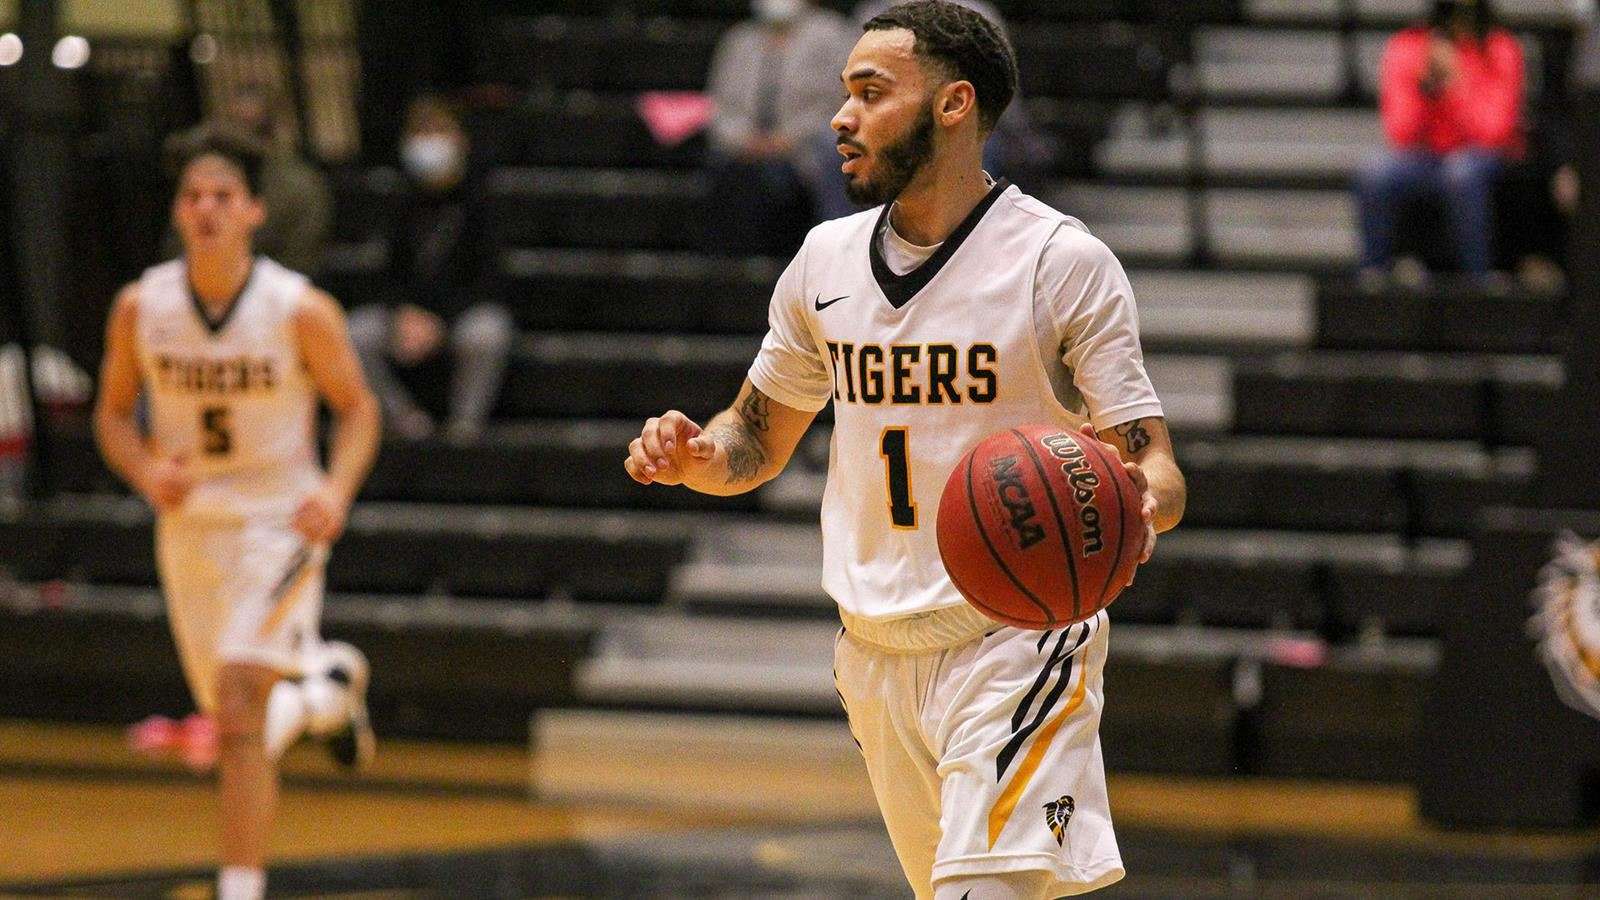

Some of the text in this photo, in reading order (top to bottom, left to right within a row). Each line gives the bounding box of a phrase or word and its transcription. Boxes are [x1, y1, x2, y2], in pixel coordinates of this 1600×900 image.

[826, 339, 998, 406] TIGERS
[202, 404, 232, 454] 5
[880, 425, 919, 530] 1
[992, 455, 1046, 550] NCAA
[1041, 432, 1104, 558] Wilson
